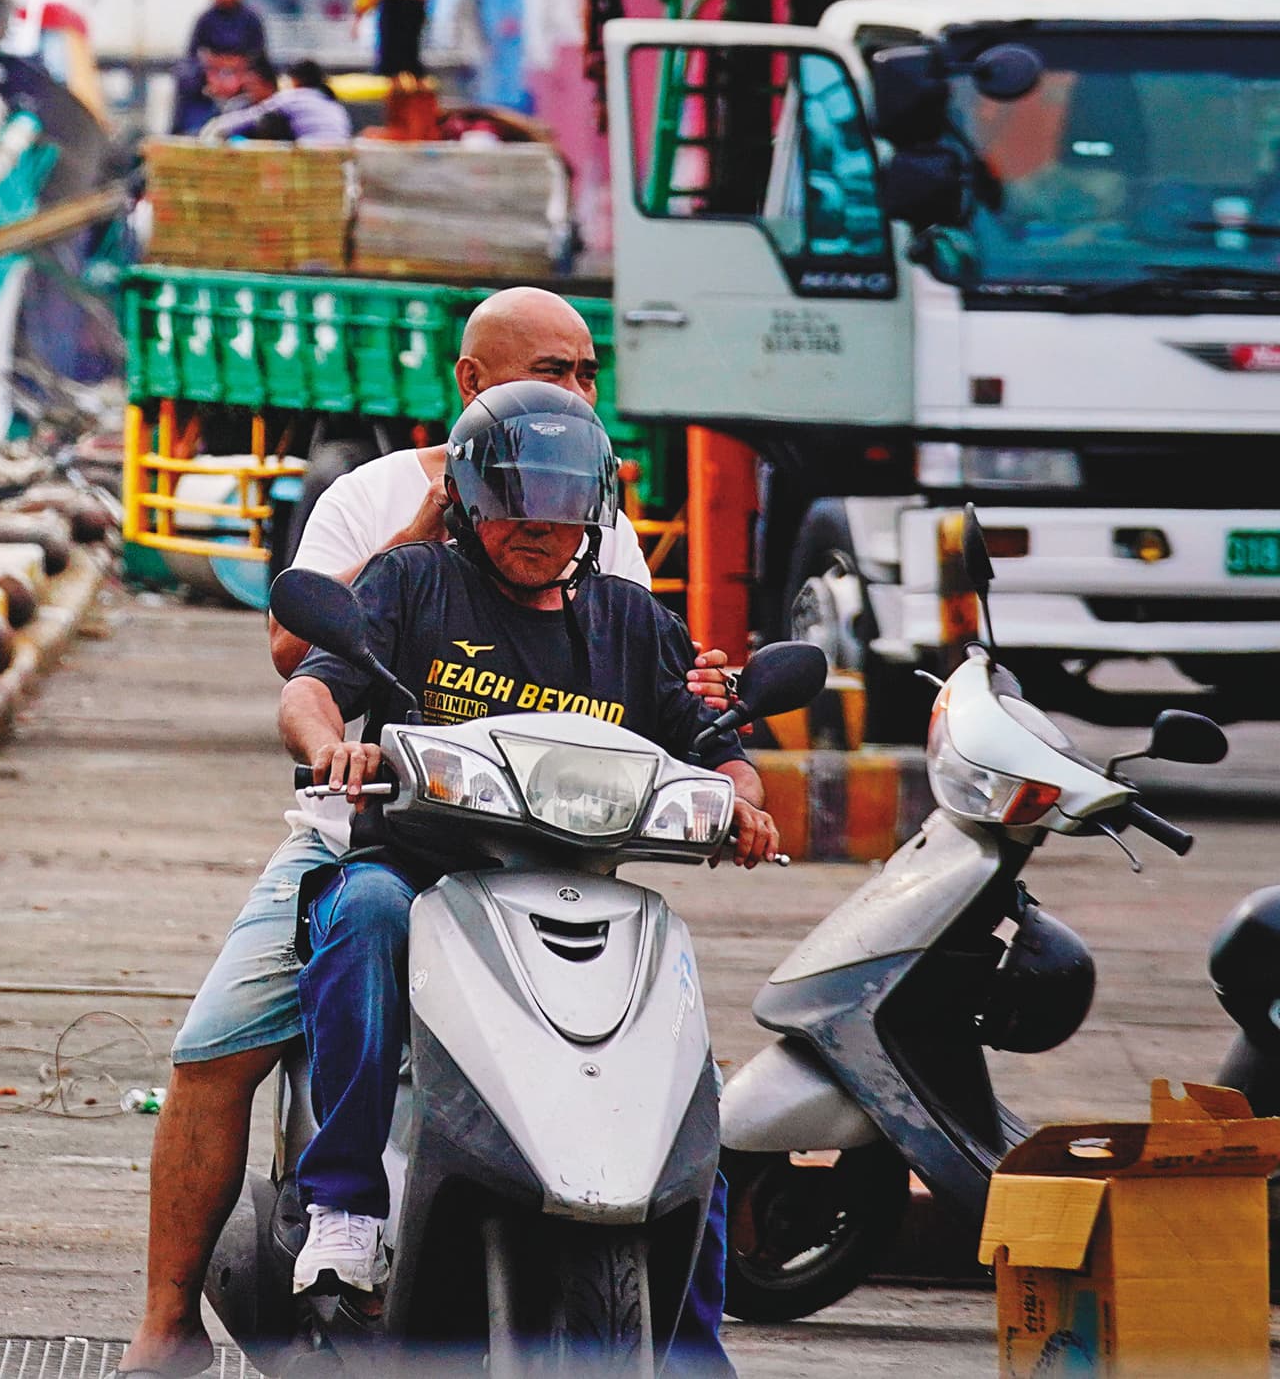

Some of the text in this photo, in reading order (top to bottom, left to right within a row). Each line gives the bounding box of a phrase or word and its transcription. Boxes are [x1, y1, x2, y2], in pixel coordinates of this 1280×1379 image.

[424, 690, 489, 718] TRAINING
[427, 659, 626, 726] REACH BEYOND
